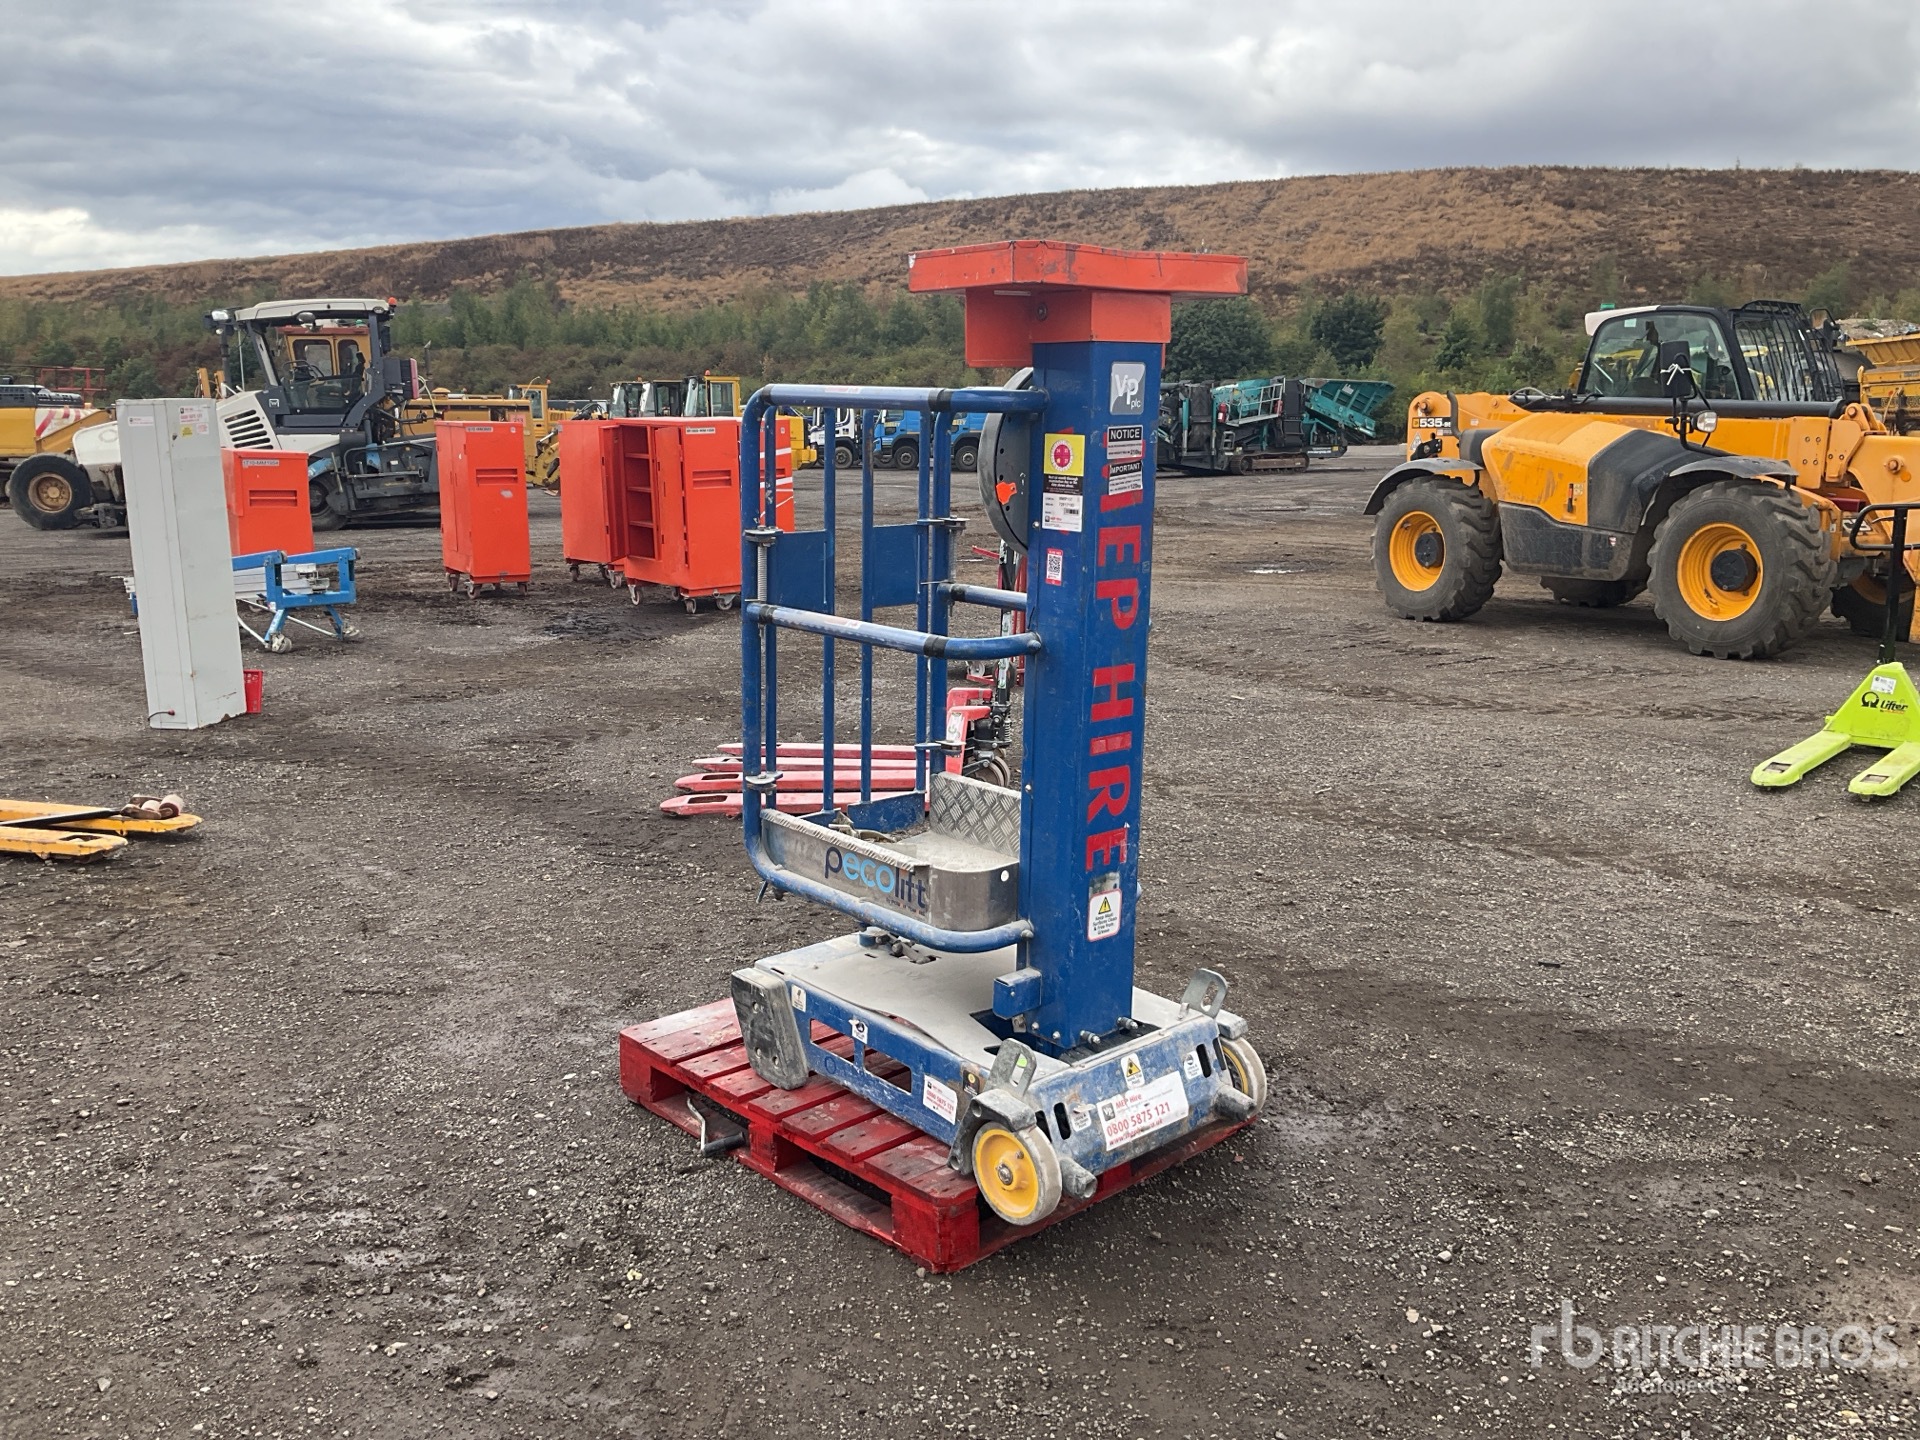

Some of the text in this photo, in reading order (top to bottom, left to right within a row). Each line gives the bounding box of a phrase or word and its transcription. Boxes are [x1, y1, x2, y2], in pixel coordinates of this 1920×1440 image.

[1110, 429, 1140, 440] NOTICE
[1110, 462, 1141, 474] IMPORTANT
[1880, 699, 1908, 711] Lifter
[1085, 663, 1135, 872] HIRE
[824, 846, 926, 909] pecolift
[1129, 1093, 1142, 1103] Hire
[1106, 1118, 1129, 1137] 0800
[1130, 1109, 1153, 1127] 5875
[1155, 1101, 1171, 1116] 121
